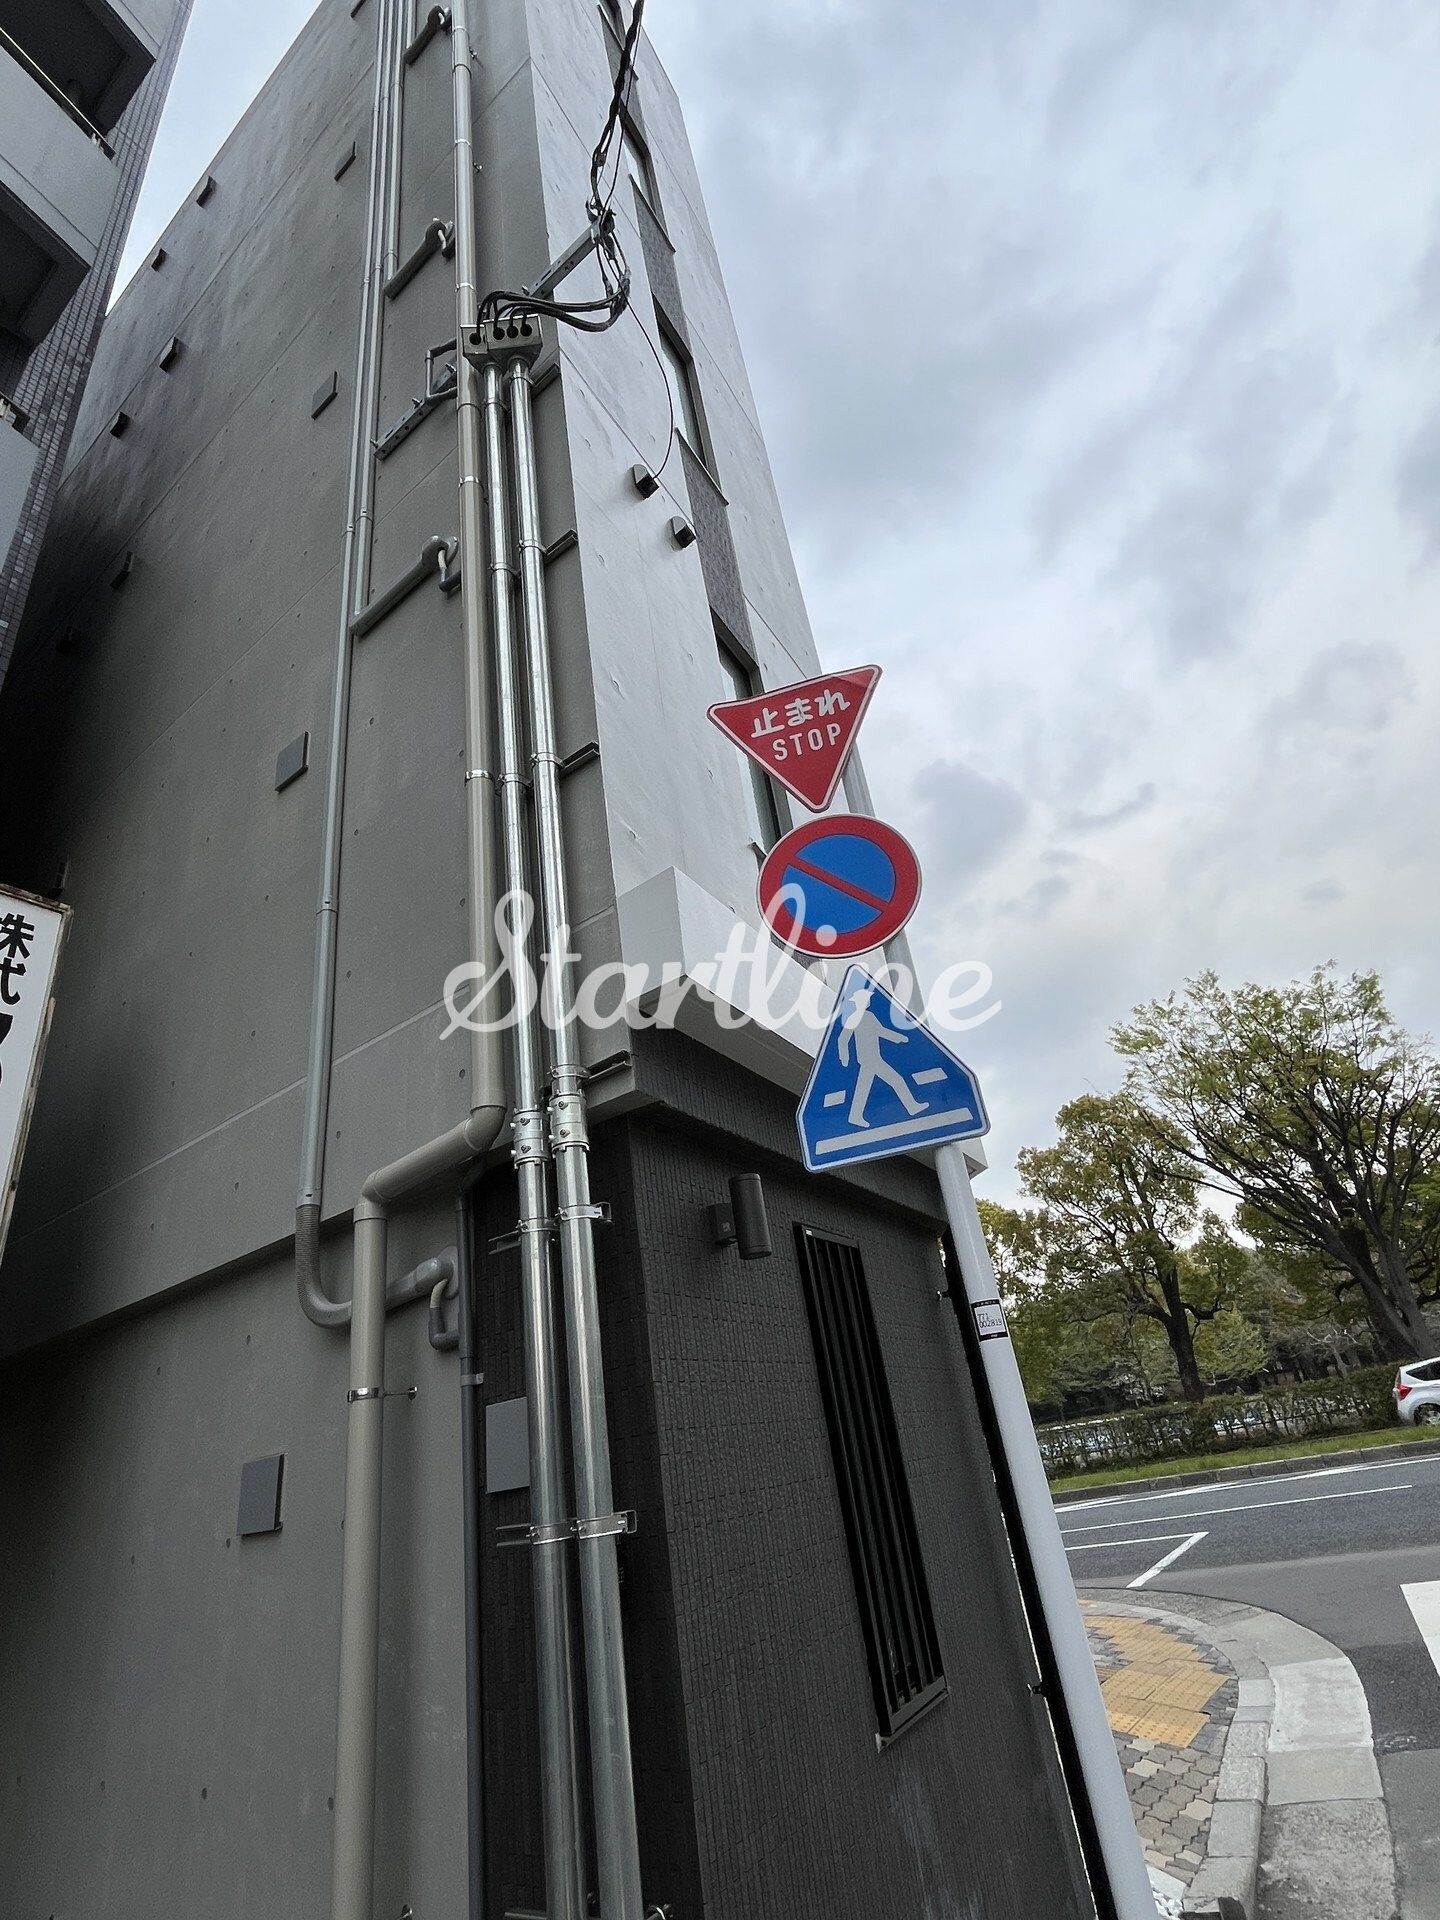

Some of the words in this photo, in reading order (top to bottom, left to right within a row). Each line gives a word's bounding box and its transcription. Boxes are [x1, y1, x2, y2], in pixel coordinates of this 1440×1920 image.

[751, 689, 850, 738] 止まれ
[772, 723, 841, 761] STOP
